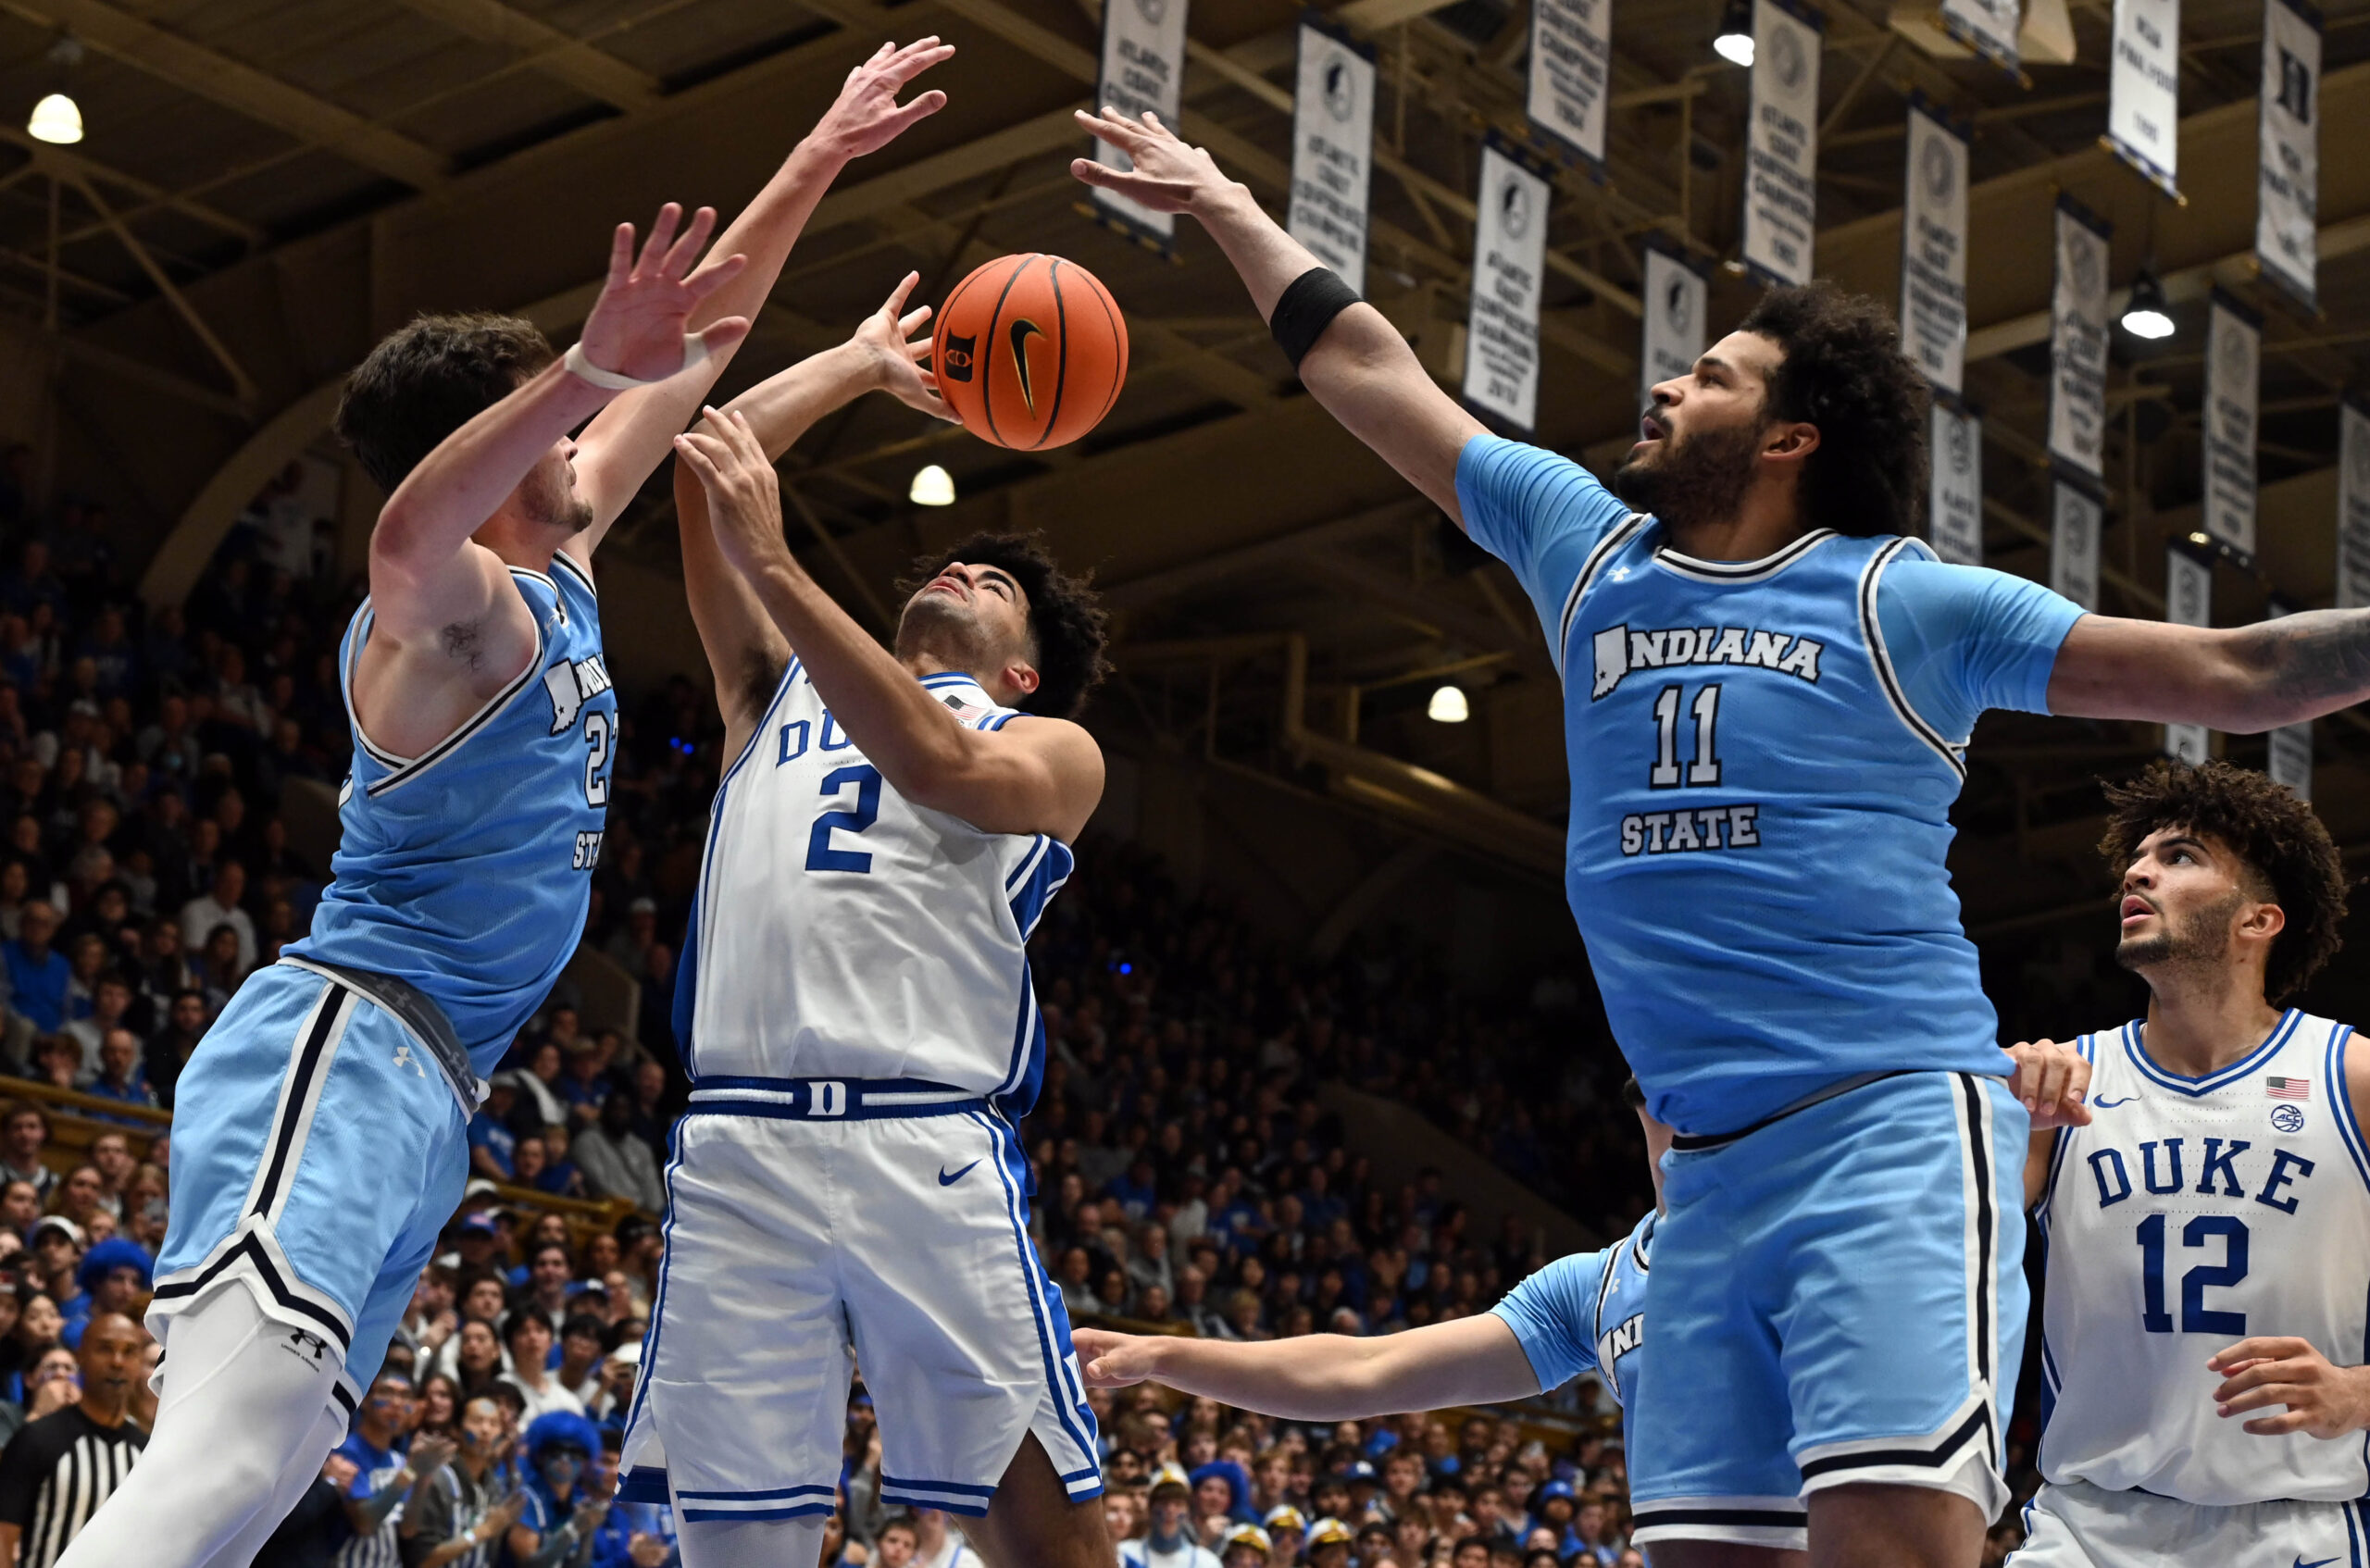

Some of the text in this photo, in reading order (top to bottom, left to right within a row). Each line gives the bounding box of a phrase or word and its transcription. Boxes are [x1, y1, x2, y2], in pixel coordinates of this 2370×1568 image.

[776, 709, 853, 769] DU
[1650, 683, 1722, 790] 11
[805, 764, 882, 874] 2
[1620, 803, 1761, 856] STATE
[2276, 1114, 2301, 1123] ACC
[2087, 1138, 2315, 1215] DUKE
[2136, 1213, 2250, 1336] 12
